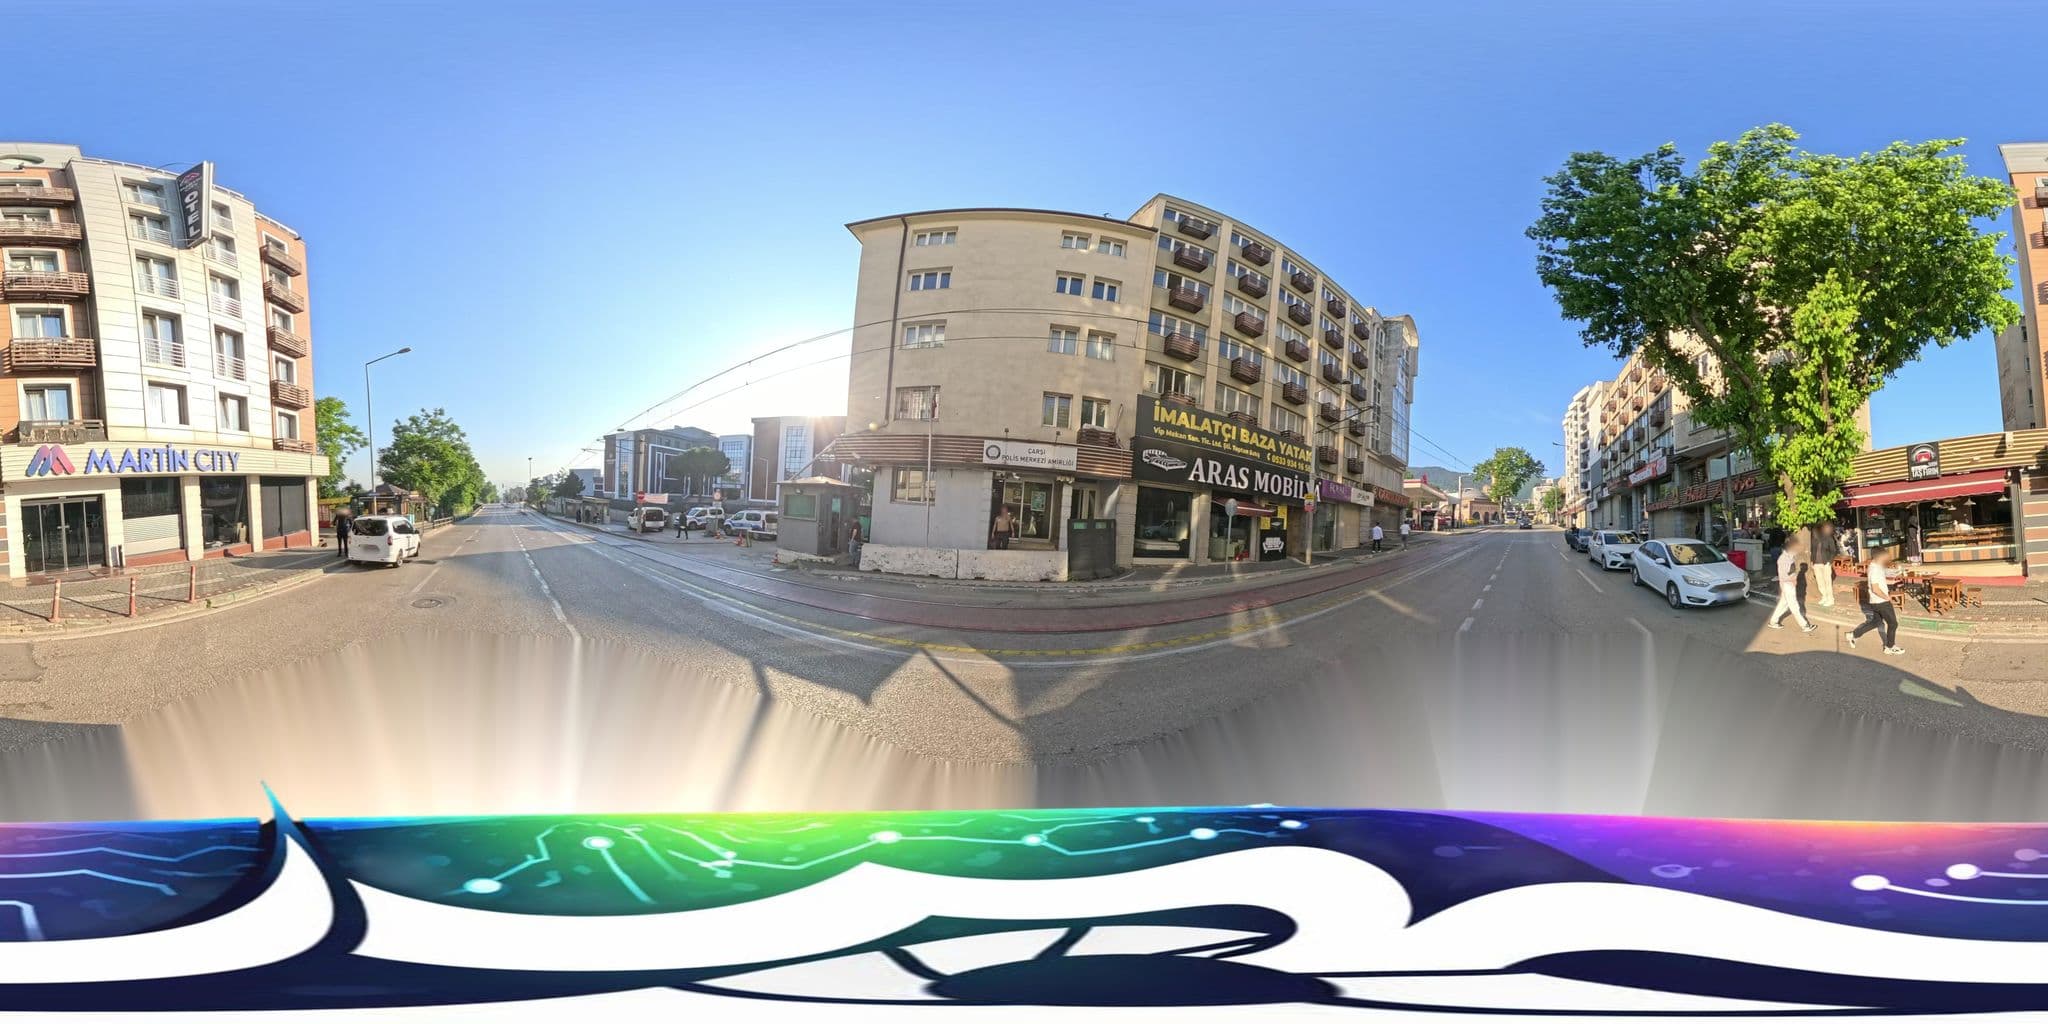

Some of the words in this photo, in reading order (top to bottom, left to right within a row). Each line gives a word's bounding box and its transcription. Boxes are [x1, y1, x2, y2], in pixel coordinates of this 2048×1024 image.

[185, 191, 201, 238] OTEL
[1154, 400, 1237, 443] İMALATÇI
[1240, 428, 1276, 452] BAZA
[1279, 441, 1312, 462] YATAK
[85, 442, 190, 474] MARTİN
[195, 449, 241, 472] CITY
[1002, 454, 1019, 462] POLİS
[1188, 457, 1249, 489] ARAS
